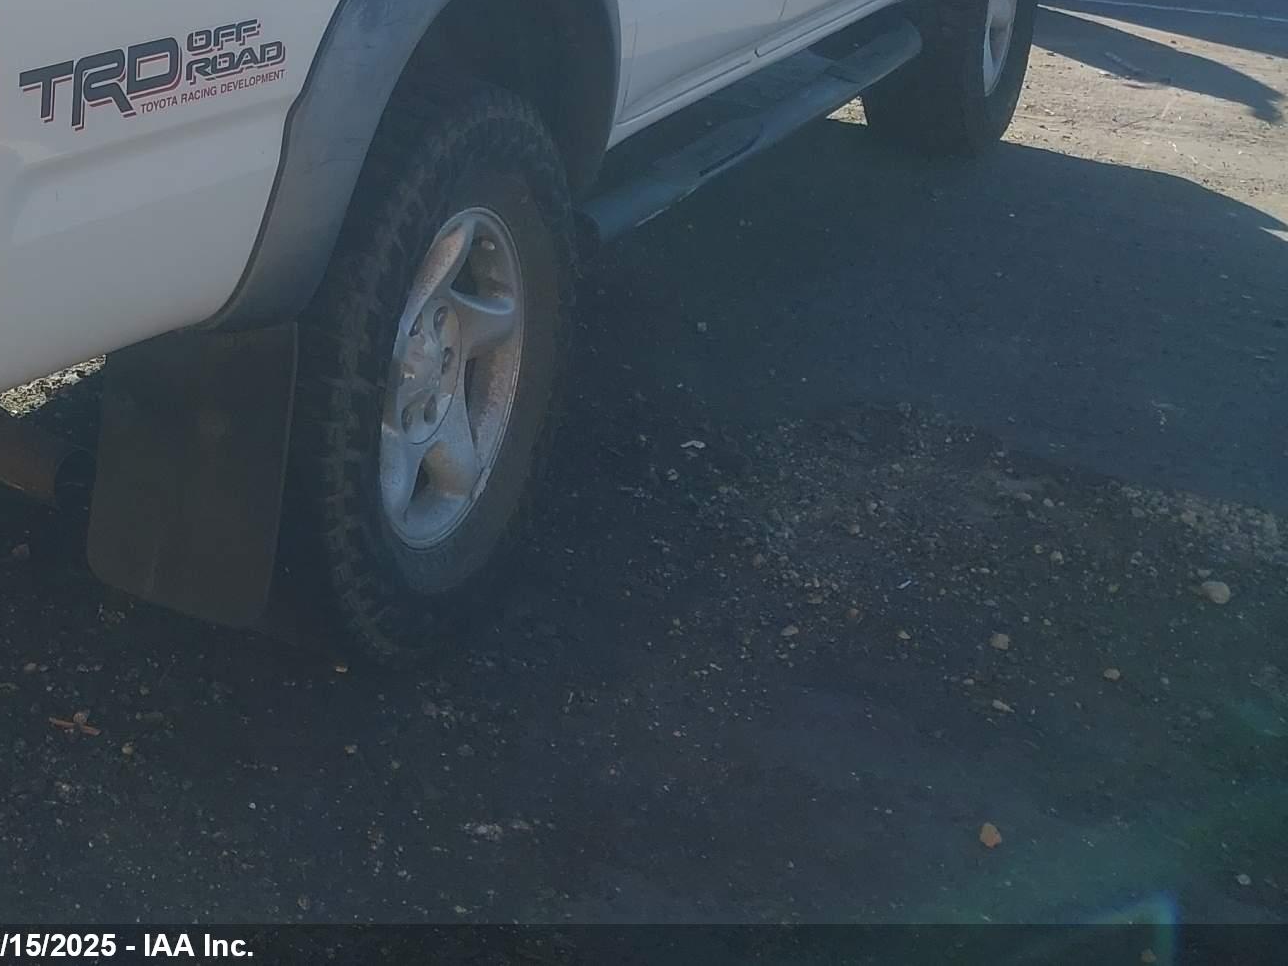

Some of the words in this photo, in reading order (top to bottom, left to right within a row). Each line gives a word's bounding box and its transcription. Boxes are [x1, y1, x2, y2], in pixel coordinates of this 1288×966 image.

[186, 19, 261, 56] OFF
[19, 36, 182, 132] TRD
[186, 40, 286, 85] ROAD
[140, 96, 178, 114] TOYOTA
[180, 87, 217, 103] RACING
[220, 69, 286, 94] DEVELOPMENT
